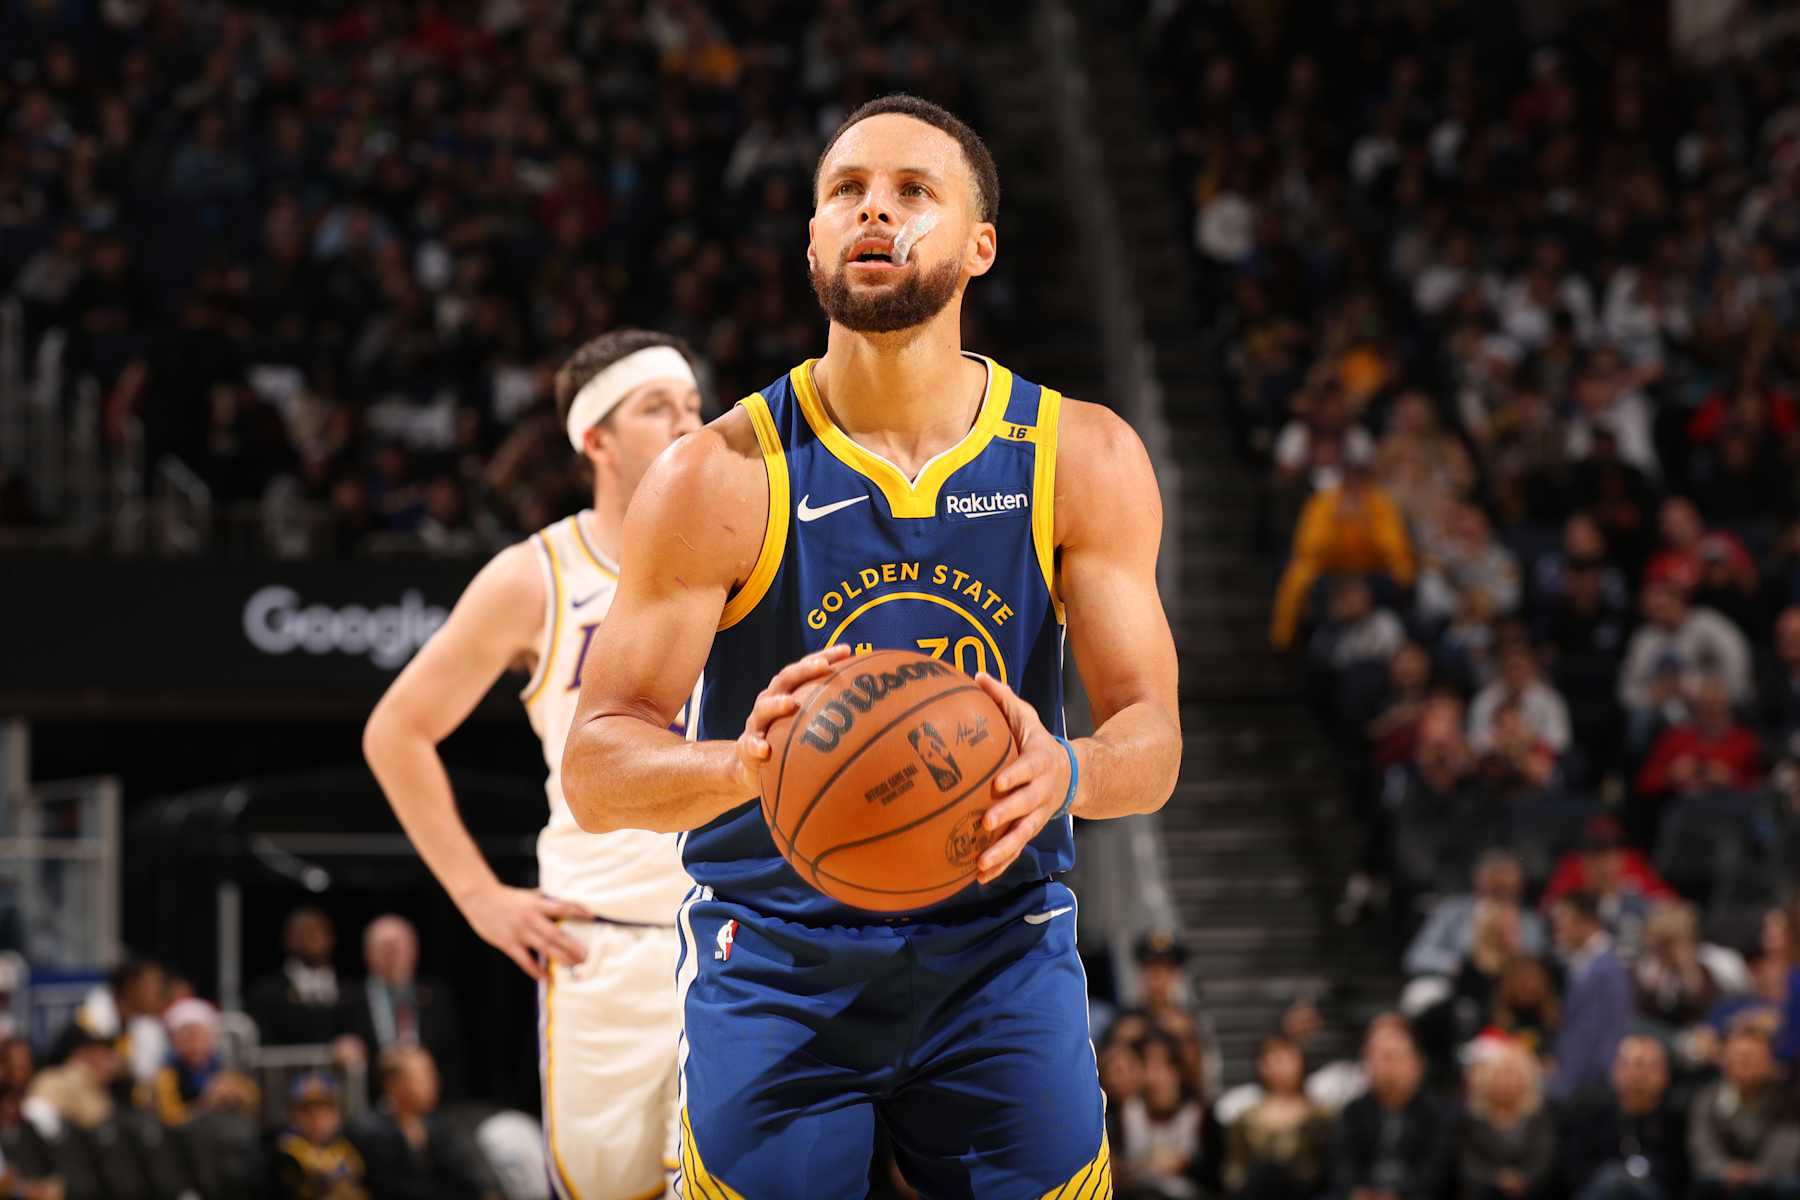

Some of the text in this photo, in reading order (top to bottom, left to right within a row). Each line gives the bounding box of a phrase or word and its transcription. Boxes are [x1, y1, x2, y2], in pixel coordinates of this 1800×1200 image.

[1008, 426, 1028, 439] 16
[946, 492, 1028, 514] Rakuten
[807, 562, 1015, 630] GOLDEN STATE
[799, 660, 954, 753] Wilson
